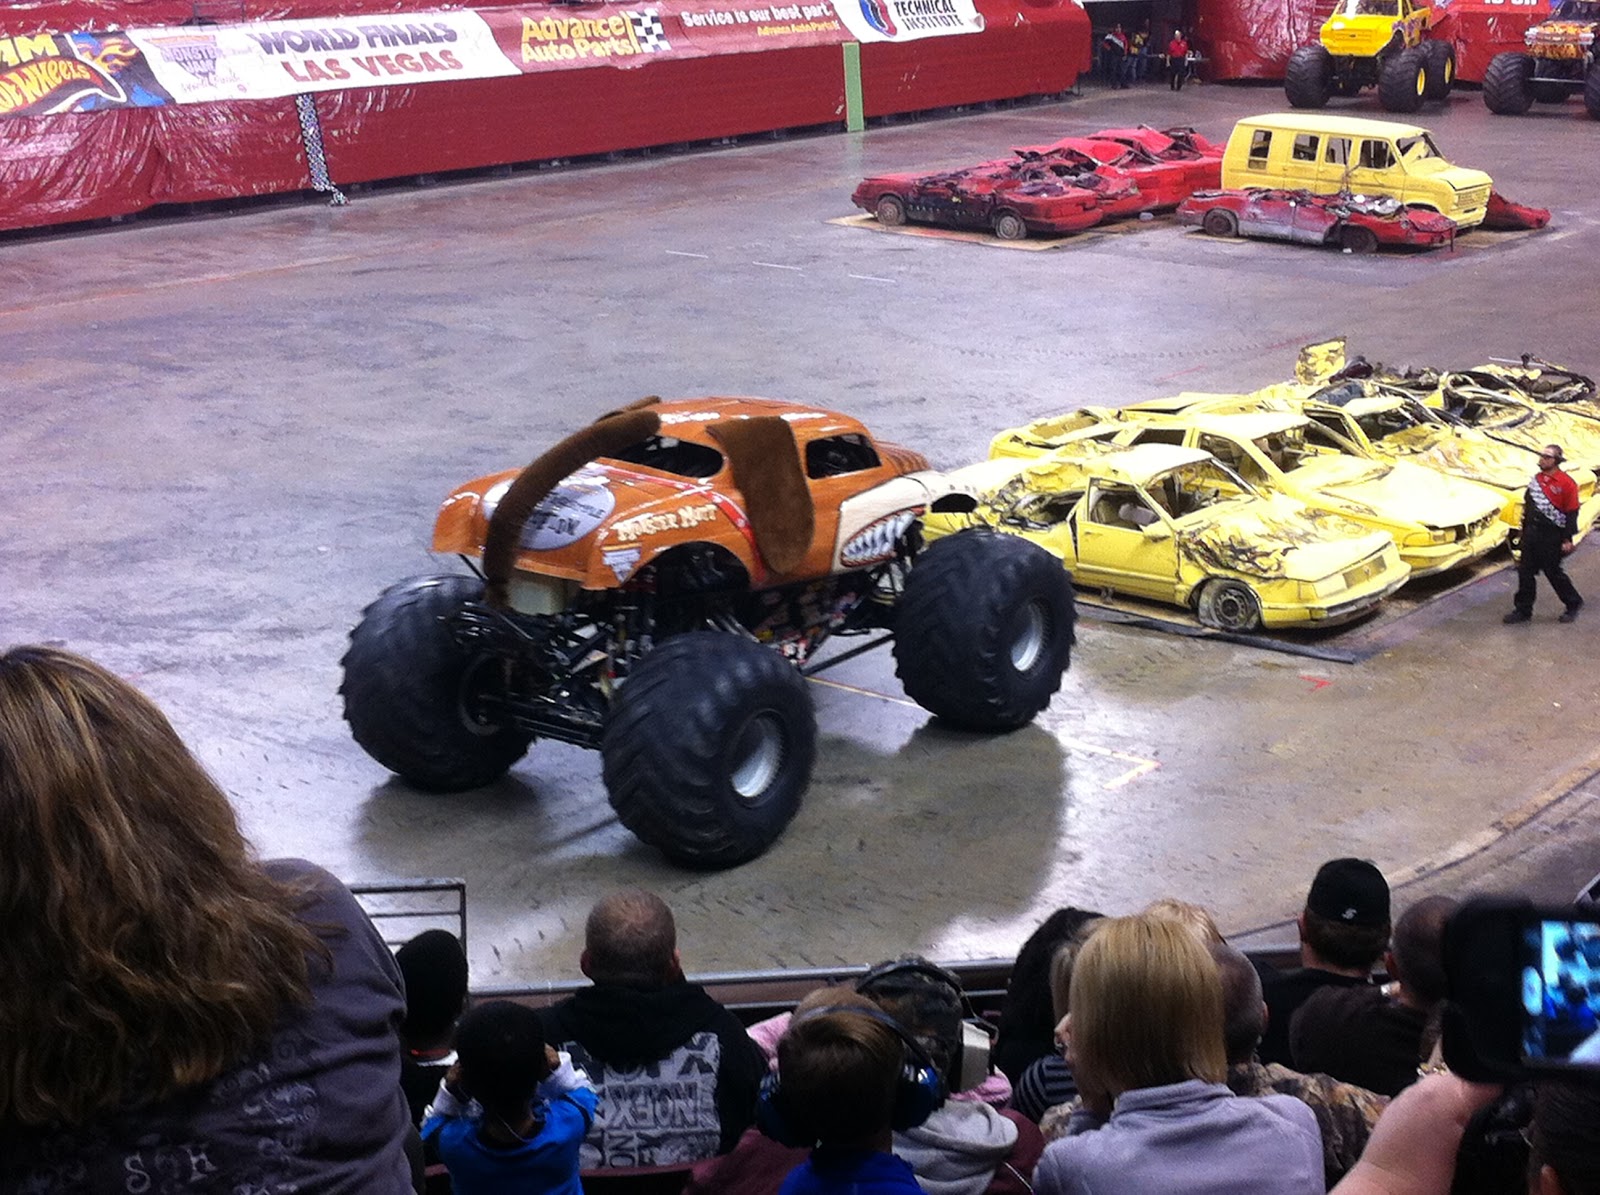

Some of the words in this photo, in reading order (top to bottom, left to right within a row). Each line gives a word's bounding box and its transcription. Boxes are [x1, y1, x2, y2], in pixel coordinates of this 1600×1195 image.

[680, 10, 734, 27] Service
[732, 8, 749, 24] is
[749, 8, 771, 22] our
[769, 4, 802, 21] best
[894, 0, 957, 17] TECHNICAL
[901, 14, 964, 31] INSTITUTE
[246, 28, 360, 55] WORLD
[356, 22, 458, 49] FINALS
[521, 15, 626, 43] Advance
[521, 40, 577, 64] Auto
[573, 36, 635, 58] Parts
[280, 58, 351, 82] LAS
[351, 49, 463, 77] VEGAS
